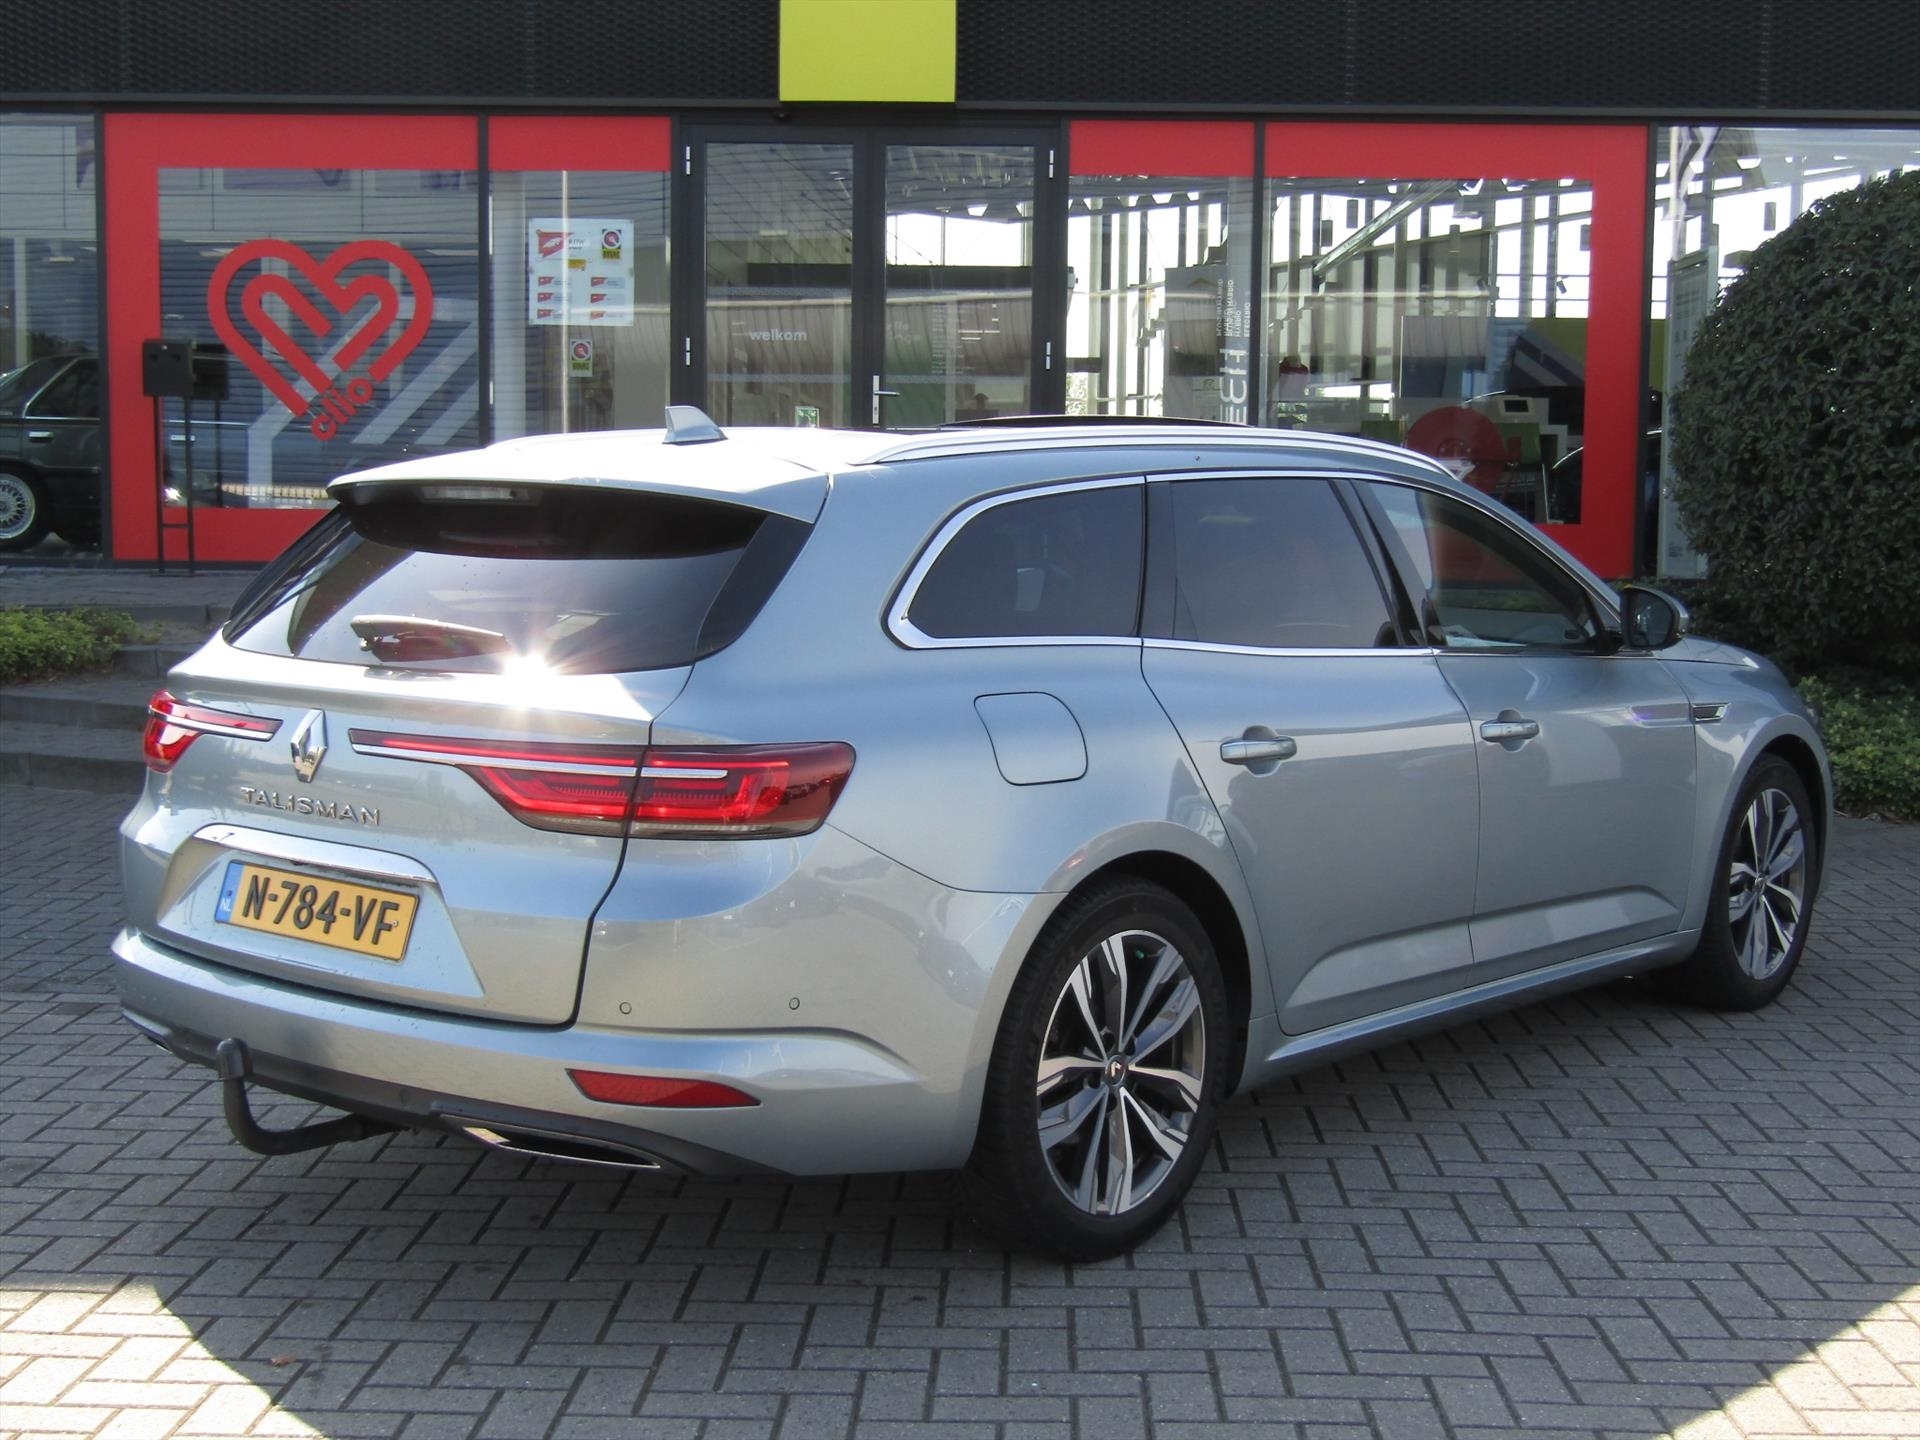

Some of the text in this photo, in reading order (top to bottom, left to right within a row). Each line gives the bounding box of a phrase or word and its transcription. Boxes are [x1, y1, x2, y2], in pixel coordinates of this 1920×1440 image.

[750, 328, 808, 341] welkom
[311, 378, 374, 441] clio
[240, 786, 381, 825] TALISMAN
[220, 895, 231, 912] NL
[242, 874, 401, 945] N-784-VF
